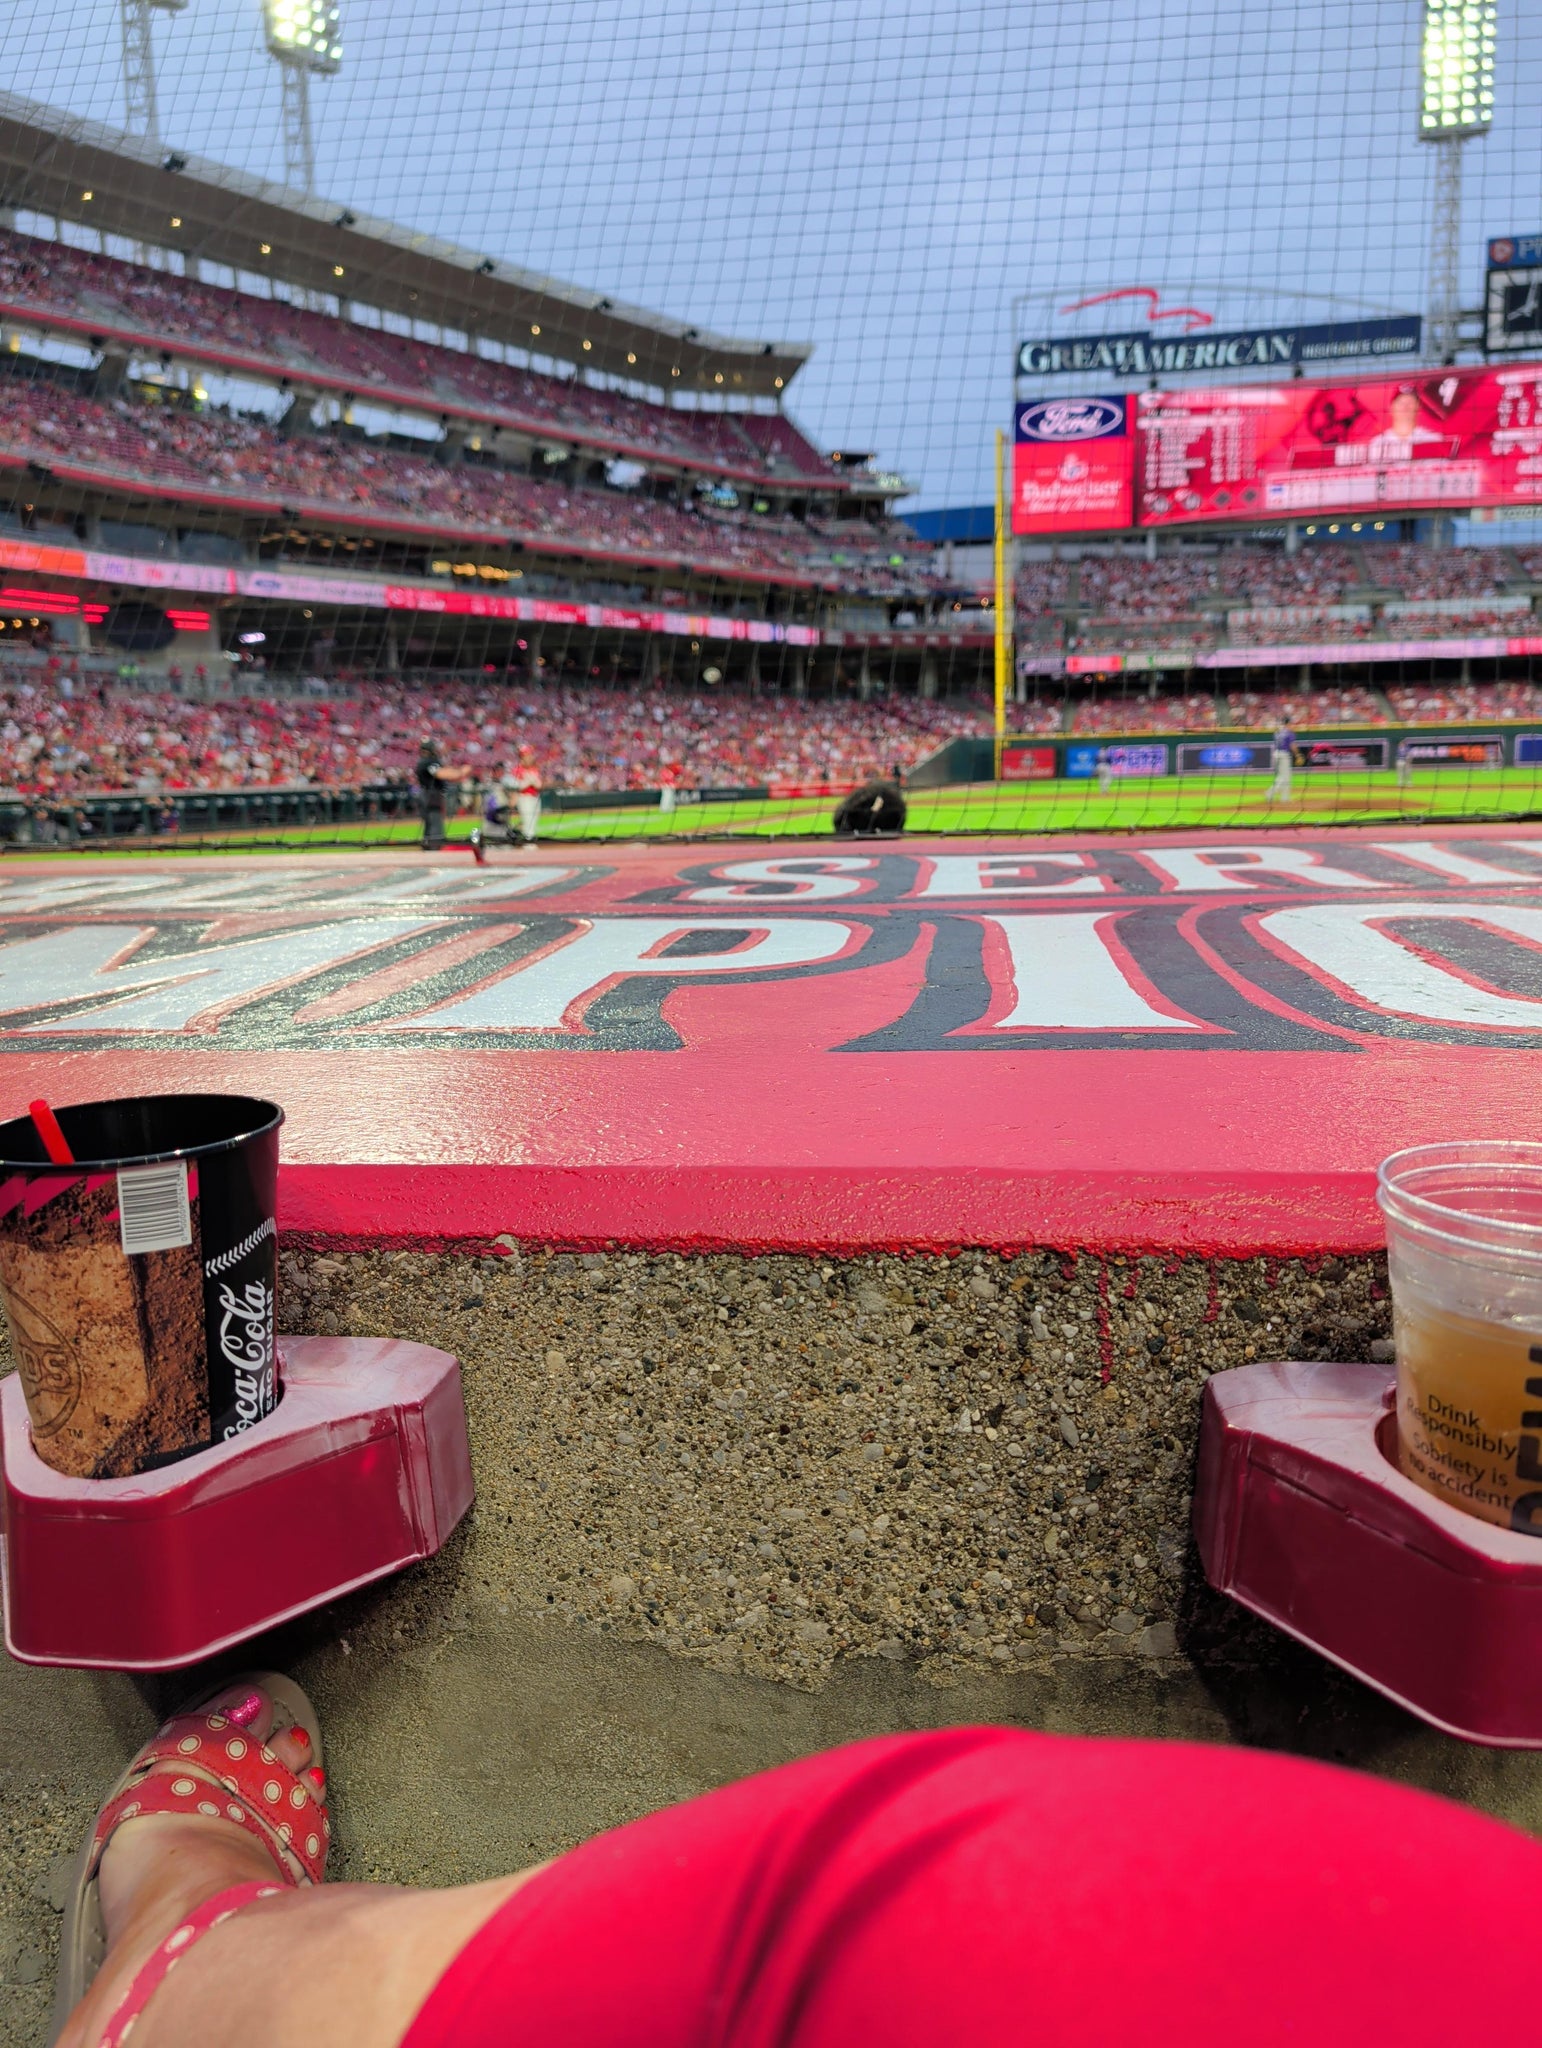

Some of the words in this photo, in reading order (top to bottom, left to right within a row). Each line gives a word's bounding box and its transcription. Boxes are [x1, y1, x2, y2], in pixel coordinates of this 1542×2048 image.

[1020, 338, 1132, 373] GREAT
[1118, 333, 1295, 373] AMERICAN
[1038, 404, 1104, 435] Ford
[266, 1287, 274, 1363] SUGAR
[1407, 1397, 1521, 1460] Responsibly.
[1428, 1394, 1481, 1431] Drink
[1408, 1452, 1426, 1474] no
[1428, 1469, 1511, 1510] accident
[1412, 1432, 1485, 1483] Sobriety
[1491, 1467, 1509, 1488] is
